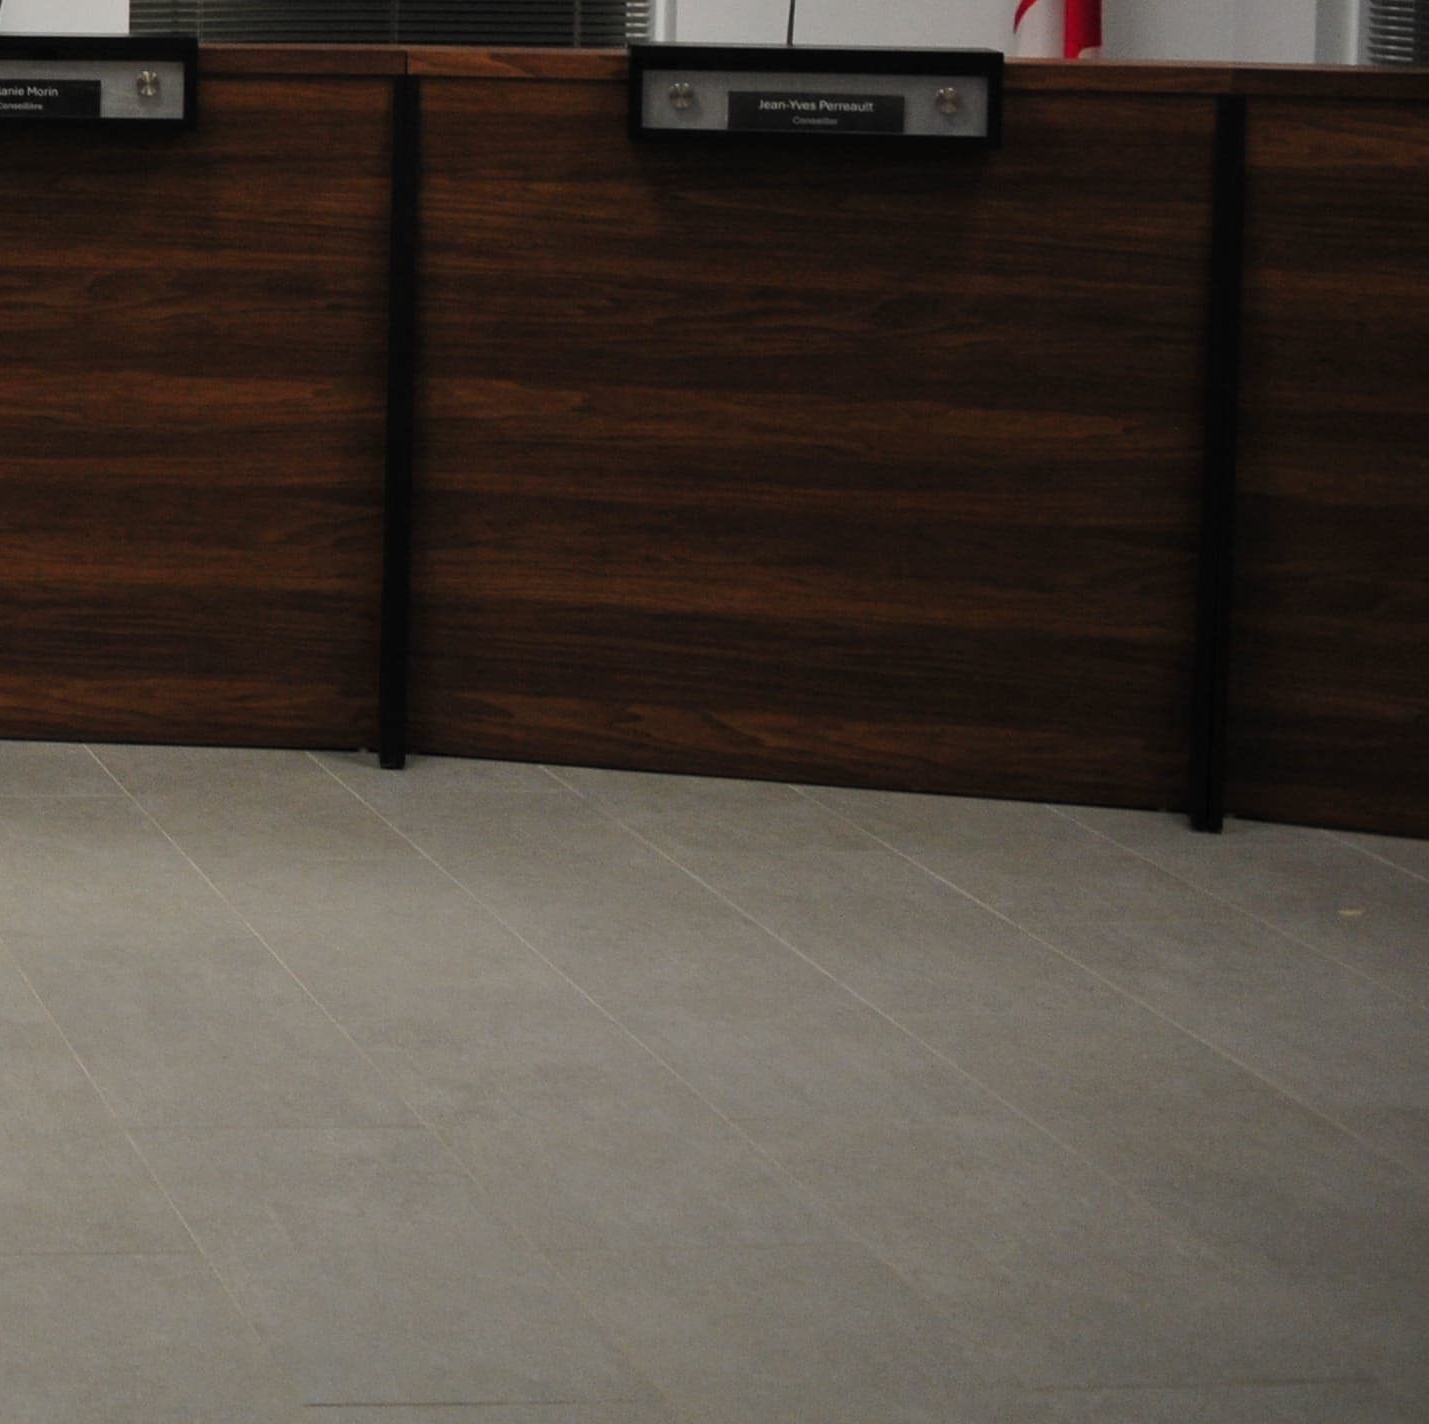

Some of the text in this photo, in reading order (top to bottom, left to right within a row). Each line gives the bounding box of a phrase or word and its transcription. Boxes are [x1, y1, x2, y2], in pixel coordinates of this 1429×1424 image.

[26, 85, 59, 97] Morin
[758, 99, 875, 113] Jean-Yves Perreault
